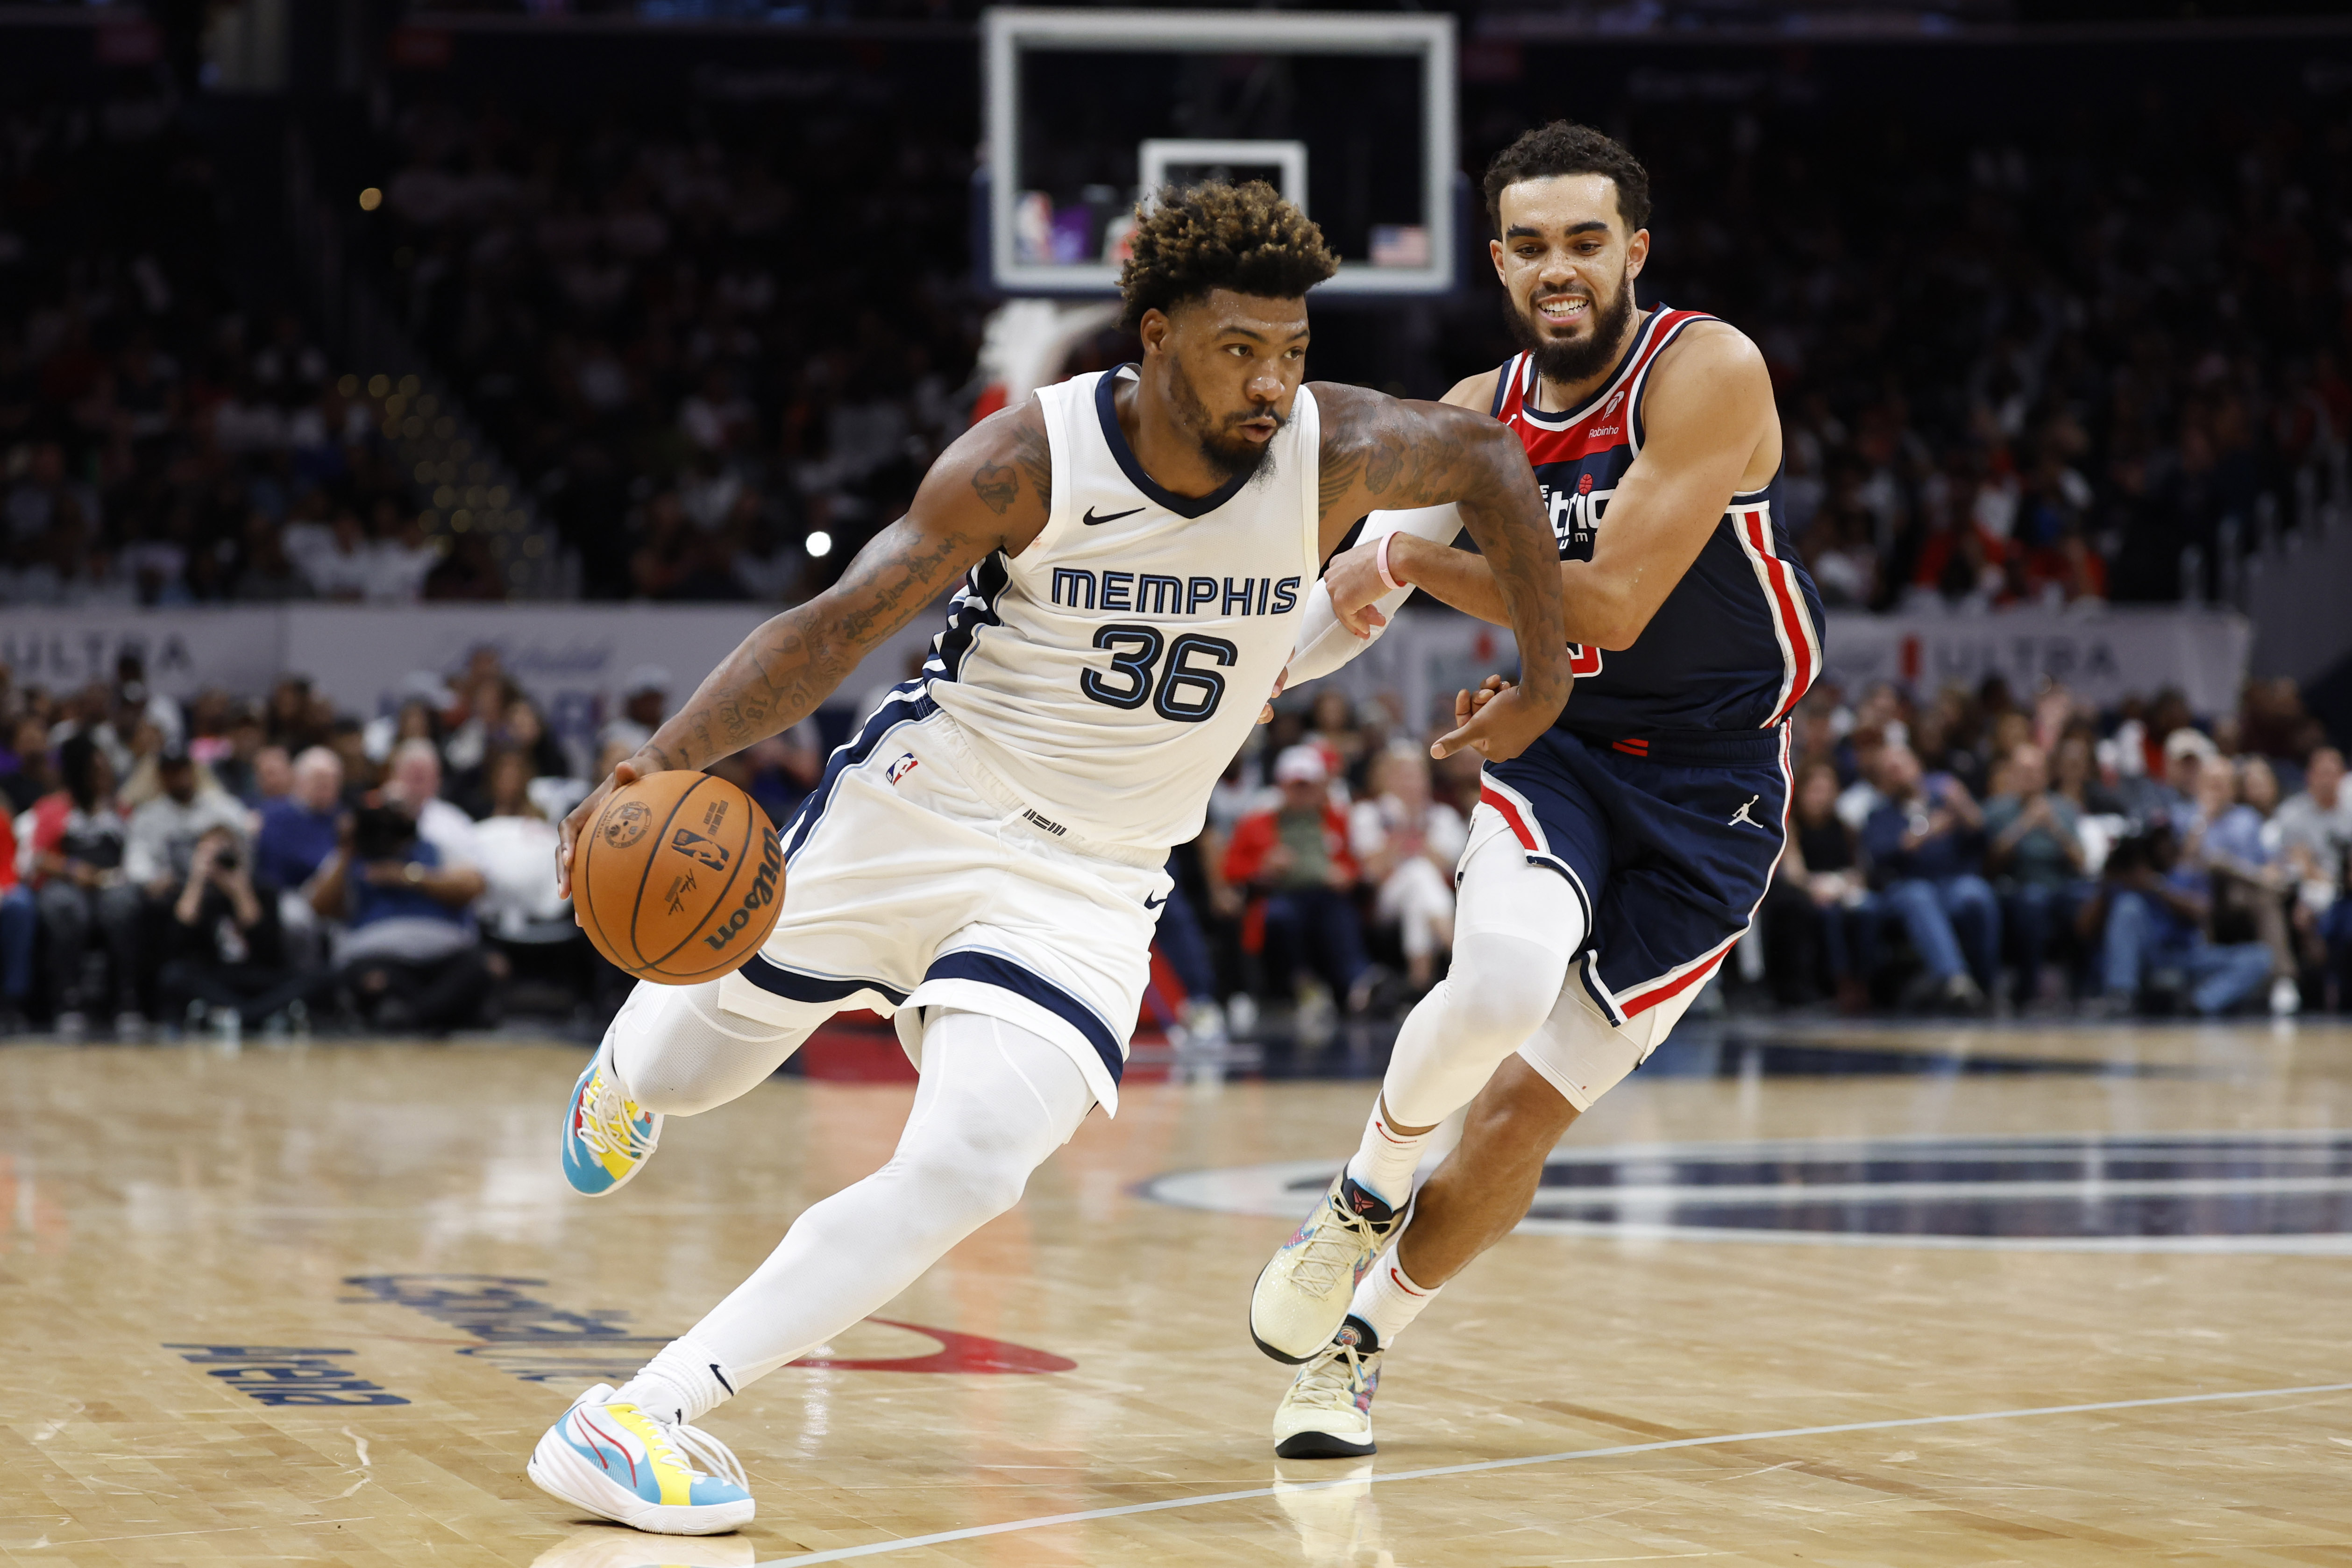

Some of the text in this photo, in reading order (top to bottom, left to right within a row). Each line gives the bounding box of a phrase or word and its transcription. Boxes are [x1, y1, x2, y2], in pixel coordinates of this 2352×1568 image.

[1052, 567, 1301, 616] MEMPHIS
[1080, 624, 1238, 723] 36
[702, 826, 782, 951] Wilson
[162, 1342, 412, 1406] Arena
